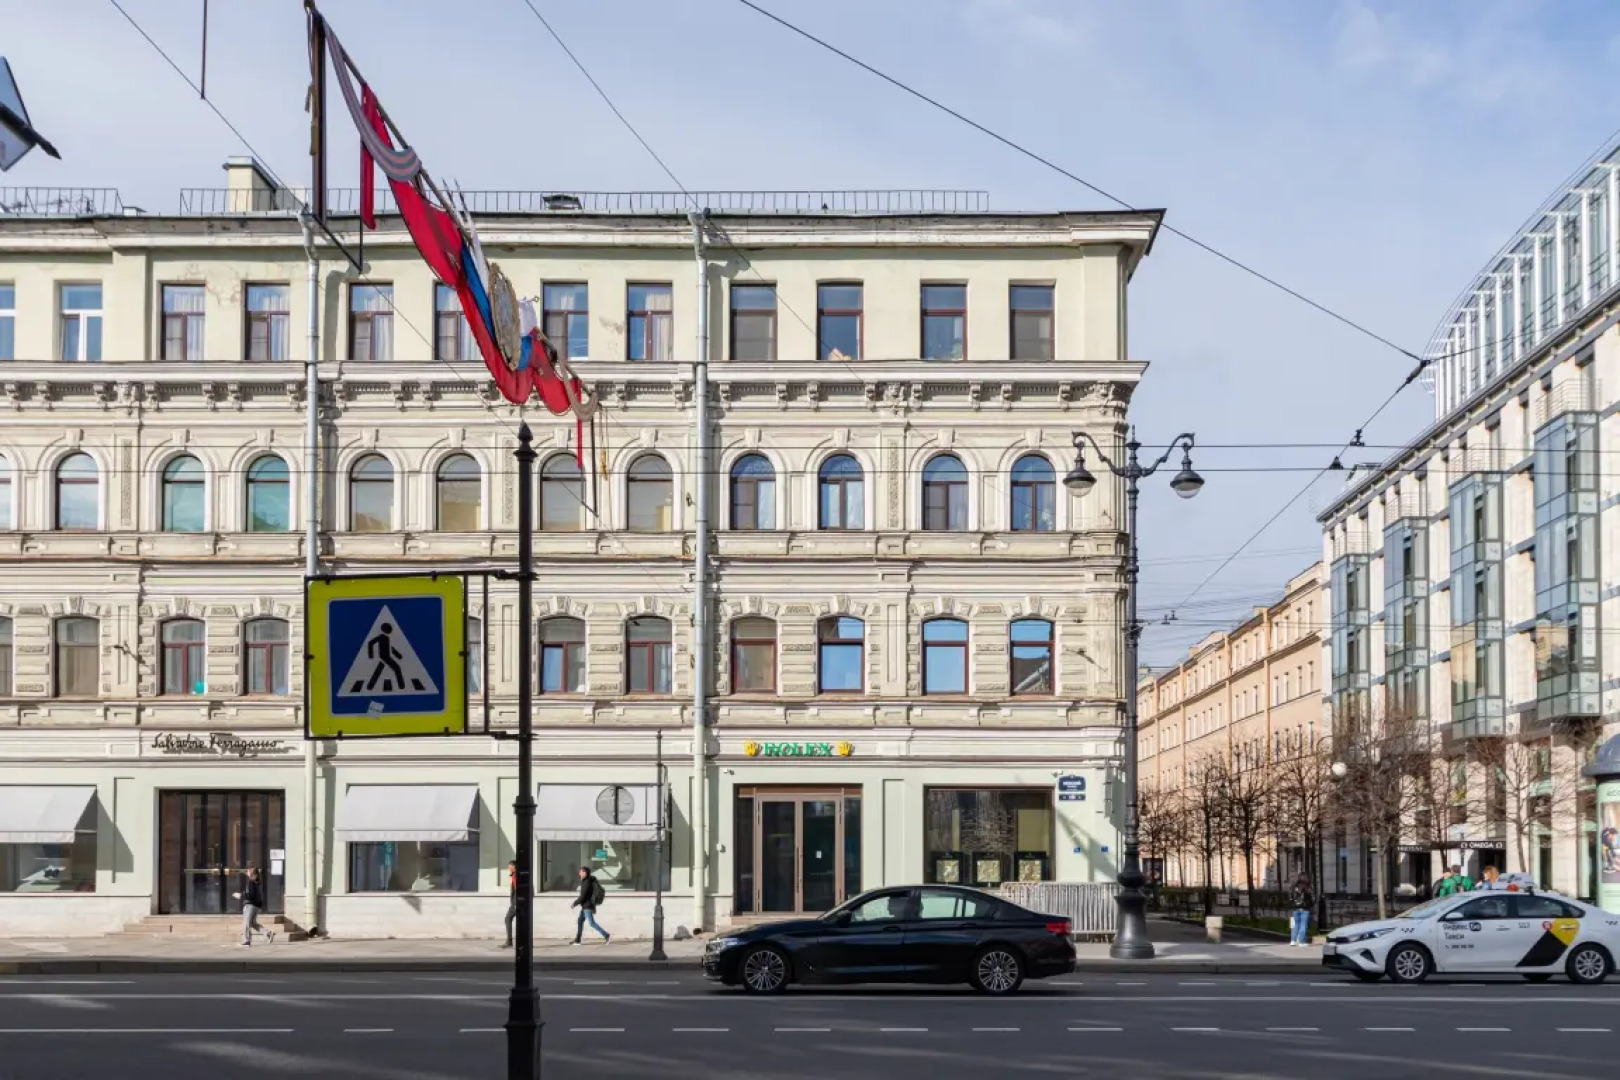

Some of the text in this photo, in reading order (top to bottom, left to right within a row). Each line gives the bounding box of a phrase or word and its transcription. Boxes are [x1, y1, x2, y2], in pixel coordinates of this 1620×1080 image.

[151, 732, 284, 758] Salvatore Ferragamo
[763, 741, 833, 757] ROLEX
[1469, 841, 1494, 849] OMEGA
